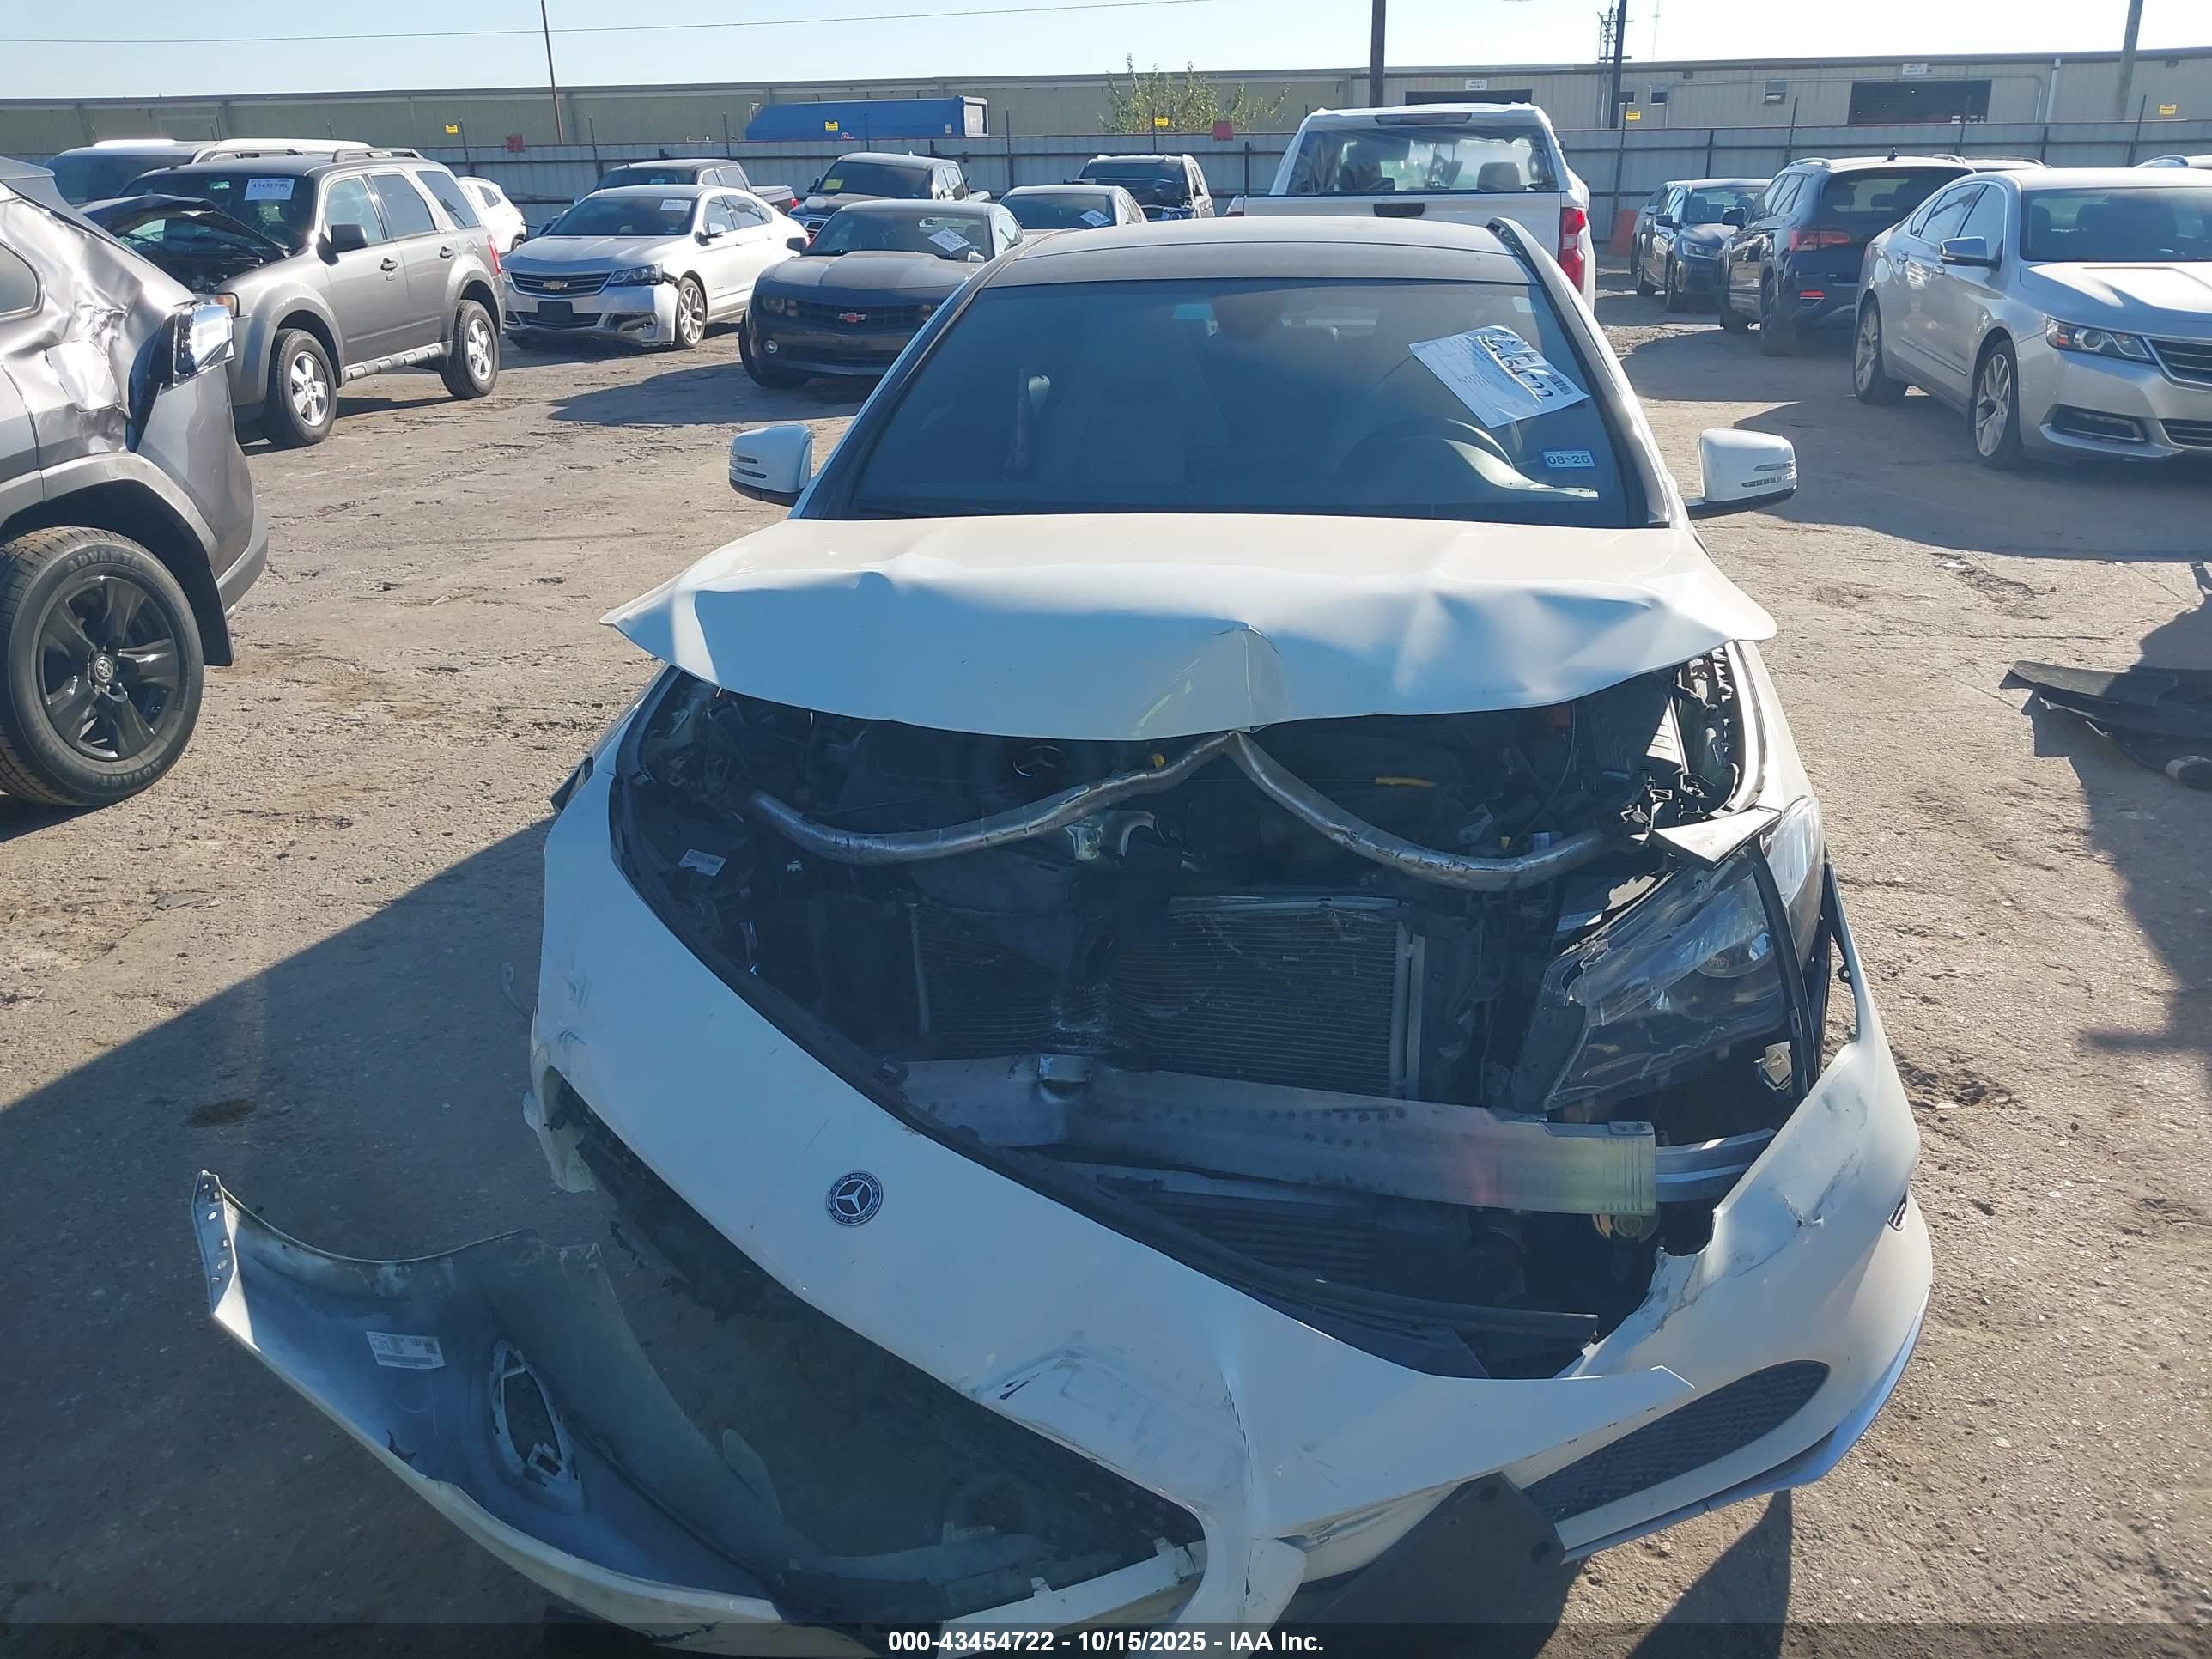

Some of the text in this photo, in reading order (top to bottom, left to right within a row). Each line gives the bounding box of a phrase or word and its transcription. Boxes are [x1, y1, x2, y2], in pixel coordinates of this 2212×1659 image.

[68, 550, 139, 574] ADVANTA
[850, 1173, 879, 1194] MERCEDES
[832, 1209, 850, 1223] BENZ
